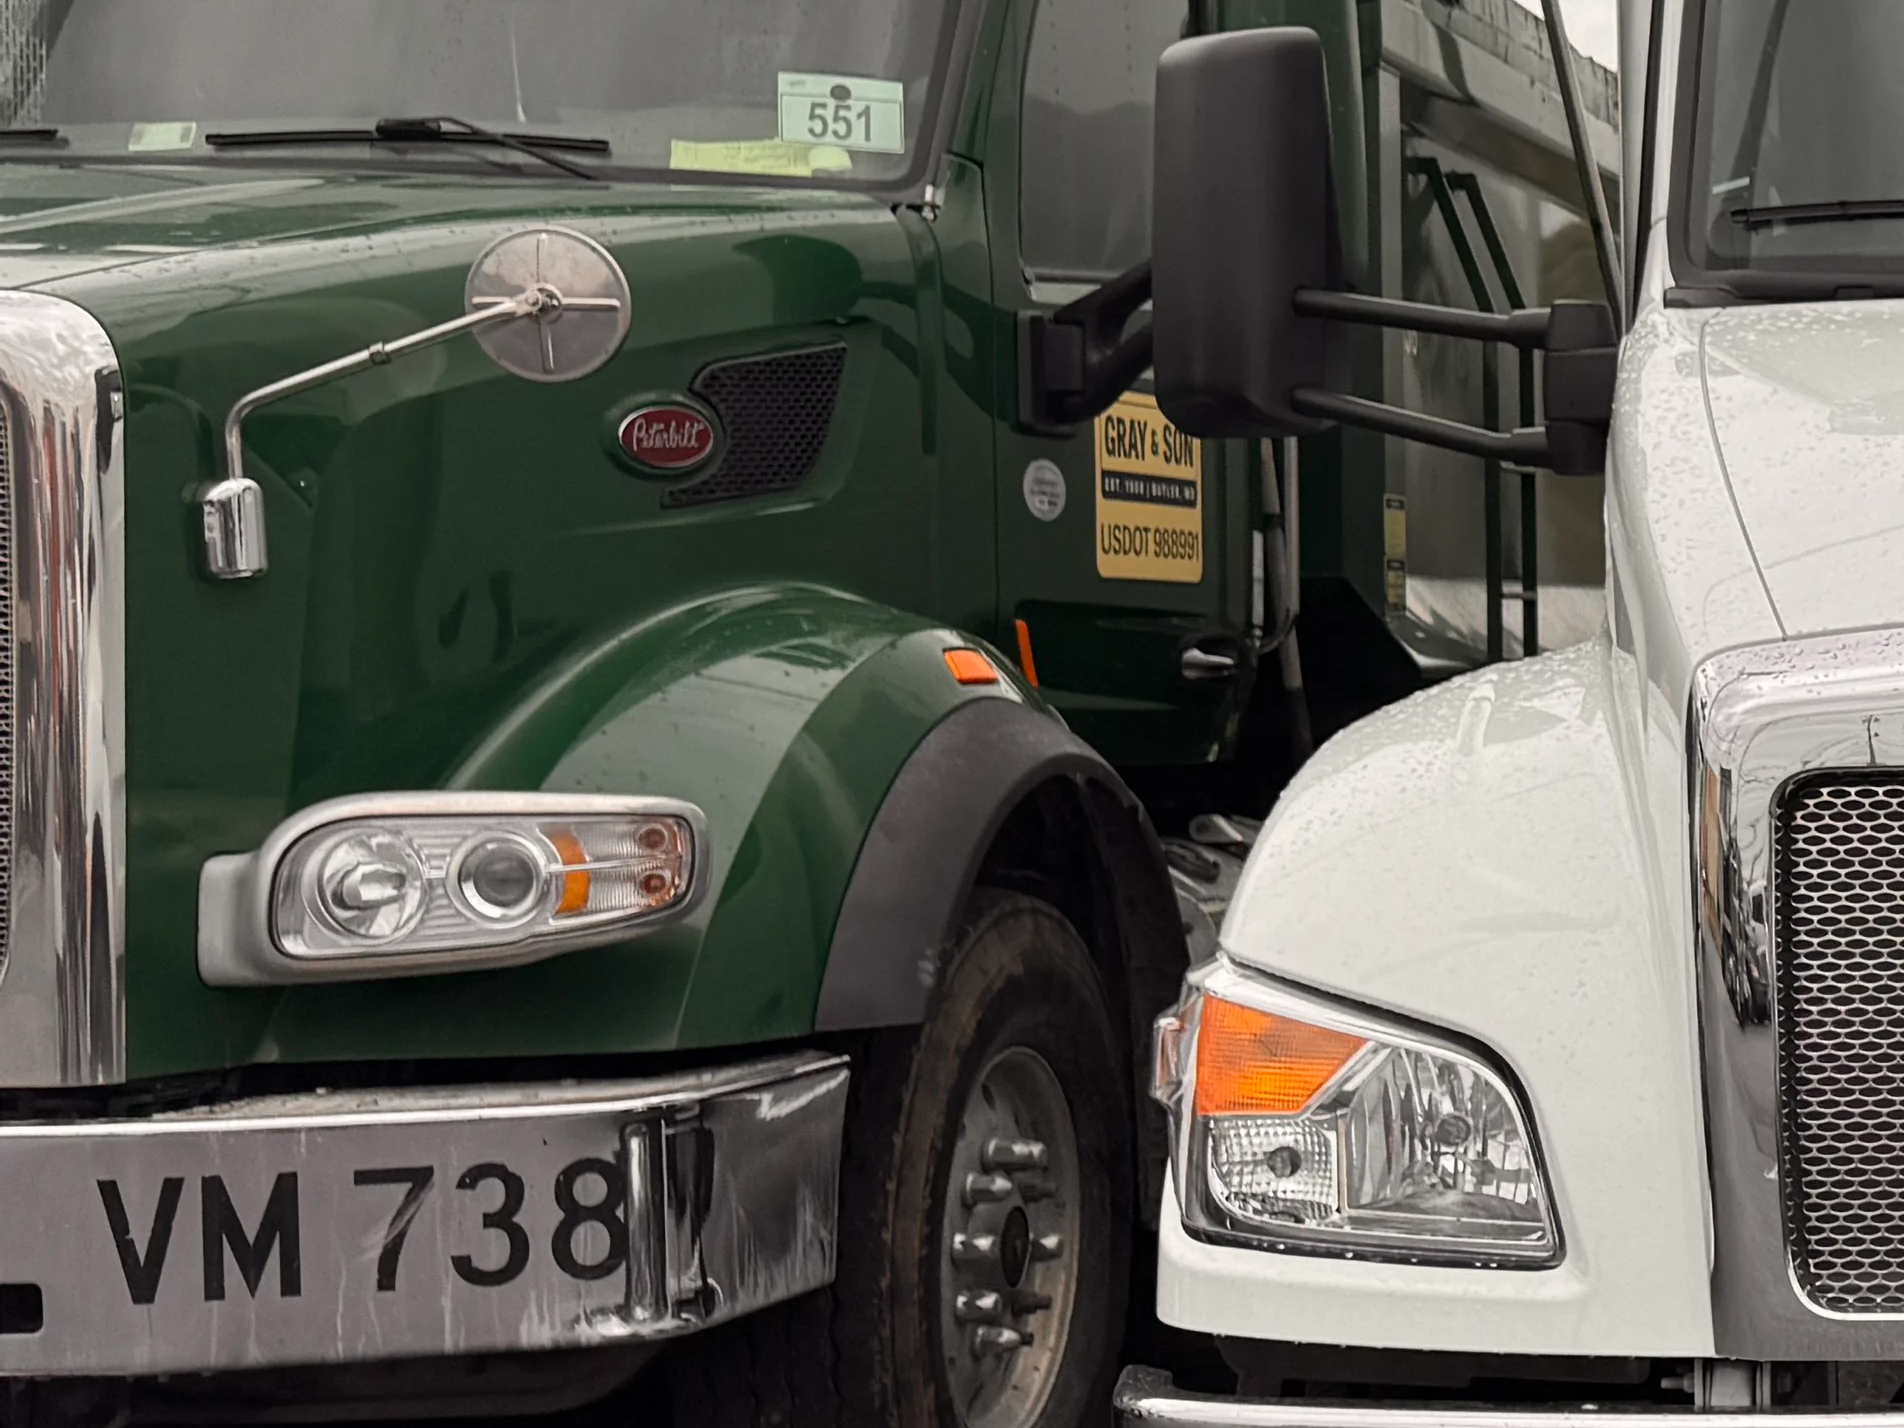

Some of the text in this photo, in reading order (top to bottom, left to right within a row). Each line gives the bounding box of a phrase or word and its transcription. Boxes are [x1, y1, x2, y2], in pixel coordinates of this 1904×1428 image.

[807, 102, 872, 143] 551
[632, 417, 705, 452] Peterbilt
[1104, 414, 1194, 468] GRAY & SON
[1100, 523, 1200, 562] USDOT 988991
[97, 1156, 627, 1305] VM 738
